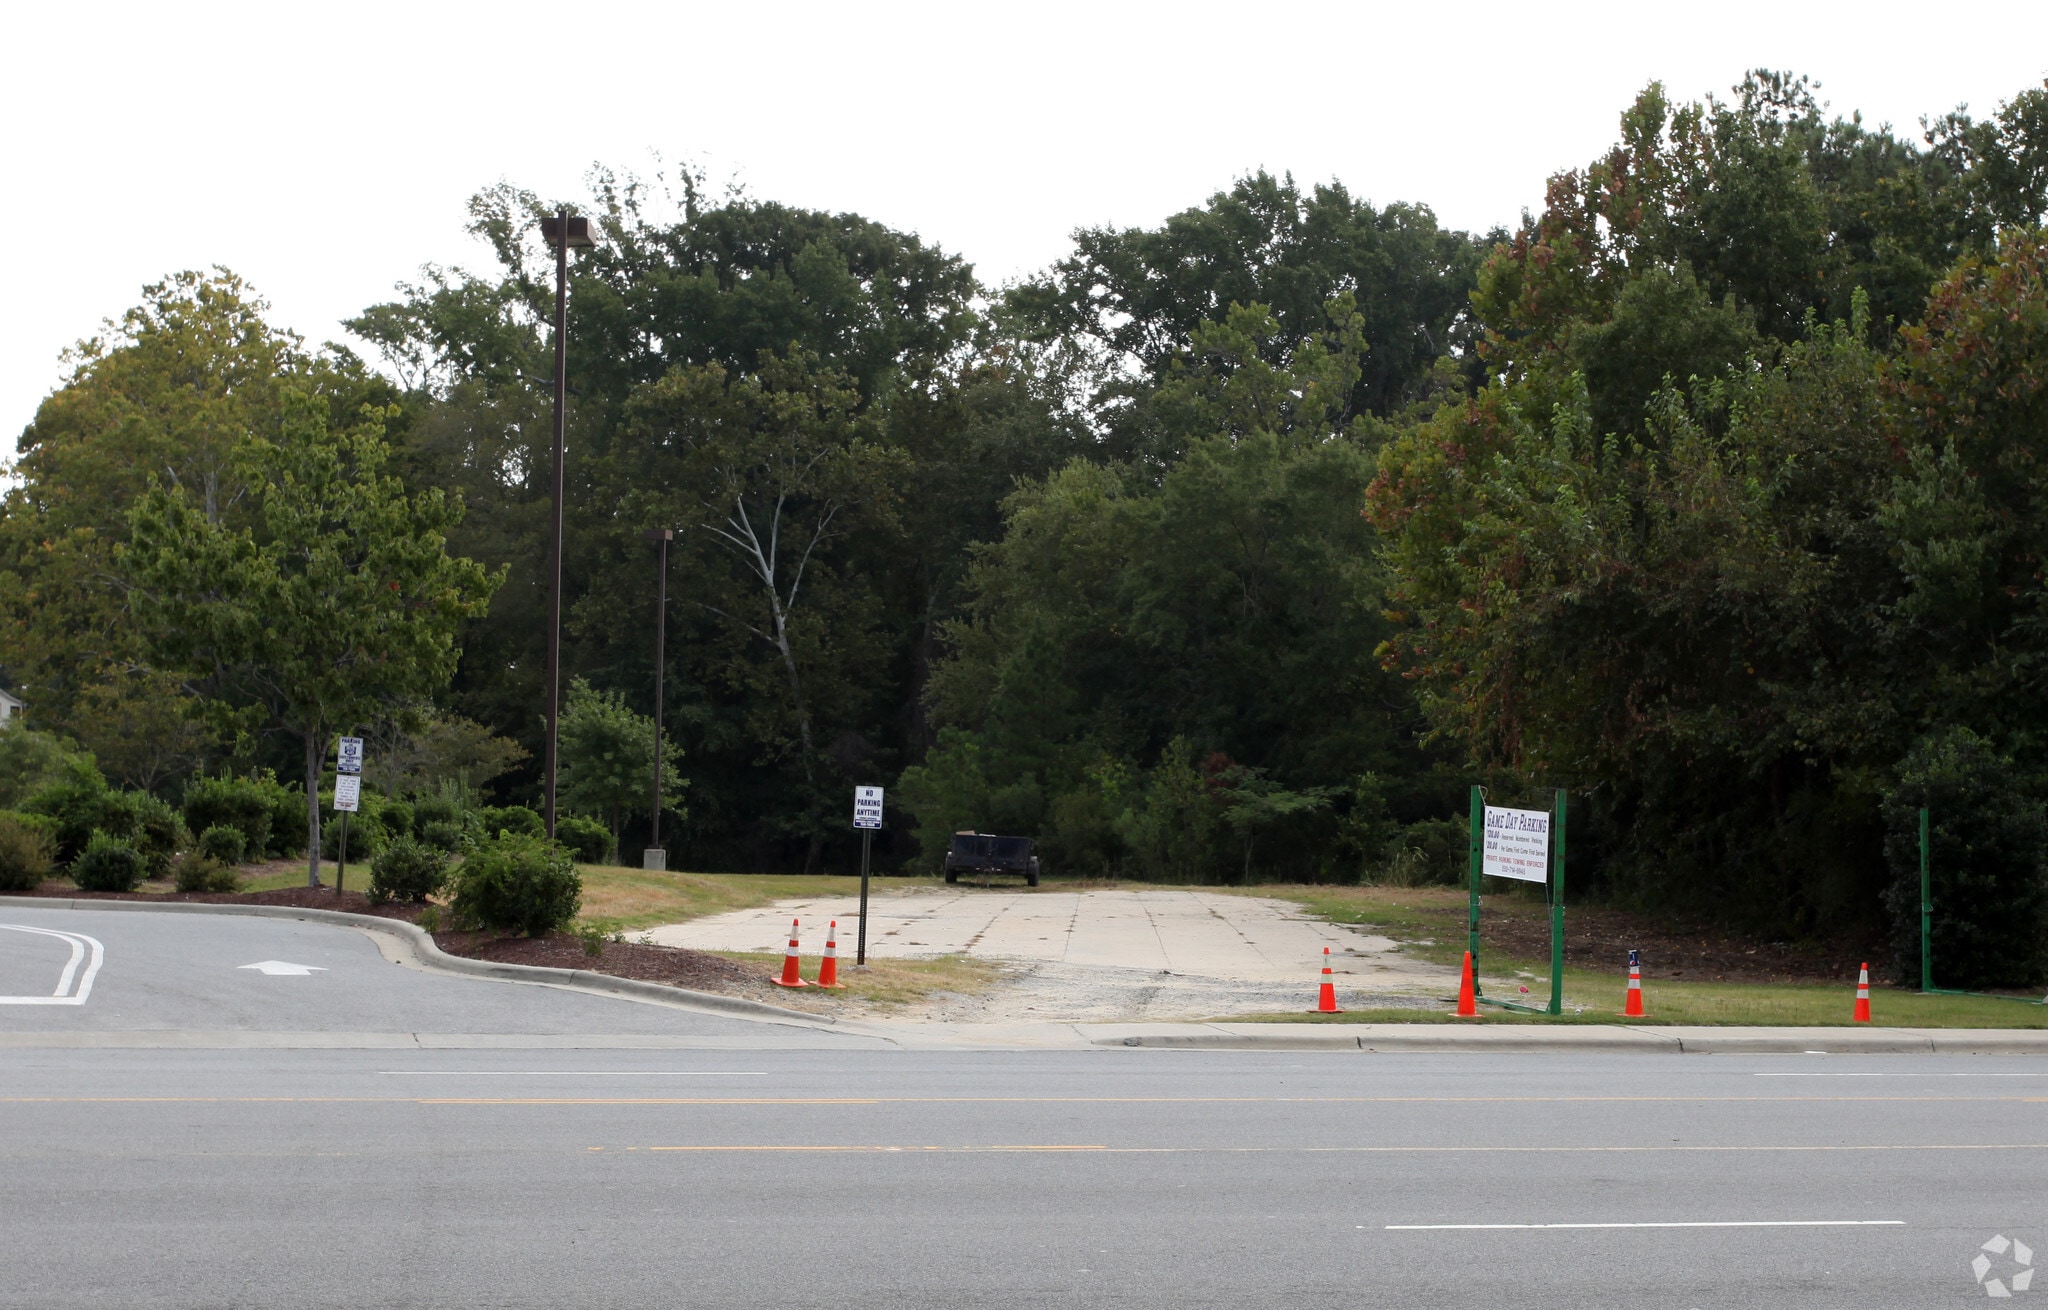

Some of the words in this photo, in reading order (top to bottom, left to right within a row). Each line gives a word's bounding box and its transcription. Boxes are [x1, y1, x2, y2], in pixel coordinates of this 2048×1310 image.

[858, 799, 880, 807] PARKING
[1505, 812, 1518, 830] DAY
[1519, 814, 1547, 833] PARKING
[1532, 837, 1542, 846] Parking
[1526, 860, 1544, 868] ENFORCED
